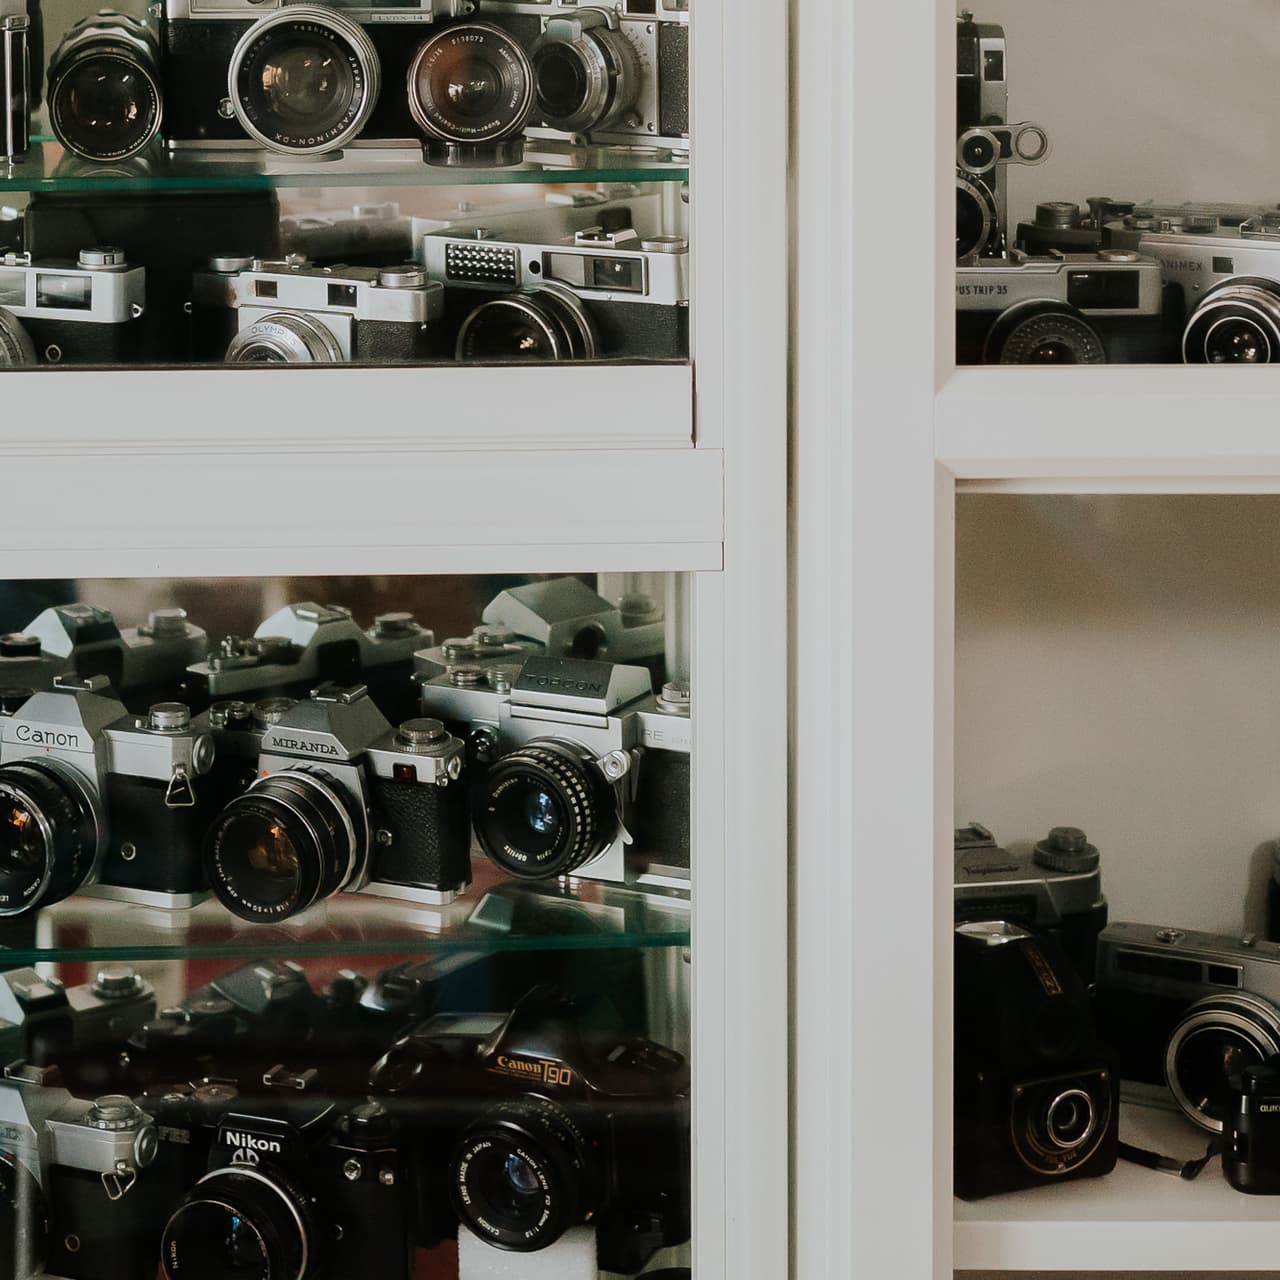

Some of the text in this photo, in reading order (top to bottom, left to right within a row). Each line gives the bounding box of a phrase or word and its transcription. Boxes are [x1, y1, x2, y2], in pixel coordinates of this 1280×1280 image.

[974, 285, 1009, 295] TRIP 35
[16, 724, 79, 748] Canon
[271, 736, 340, 756] MIRANDA
[496, 1055, 572, 1087] Canon T90
[224, 1130, 282, 1154] Nikon
